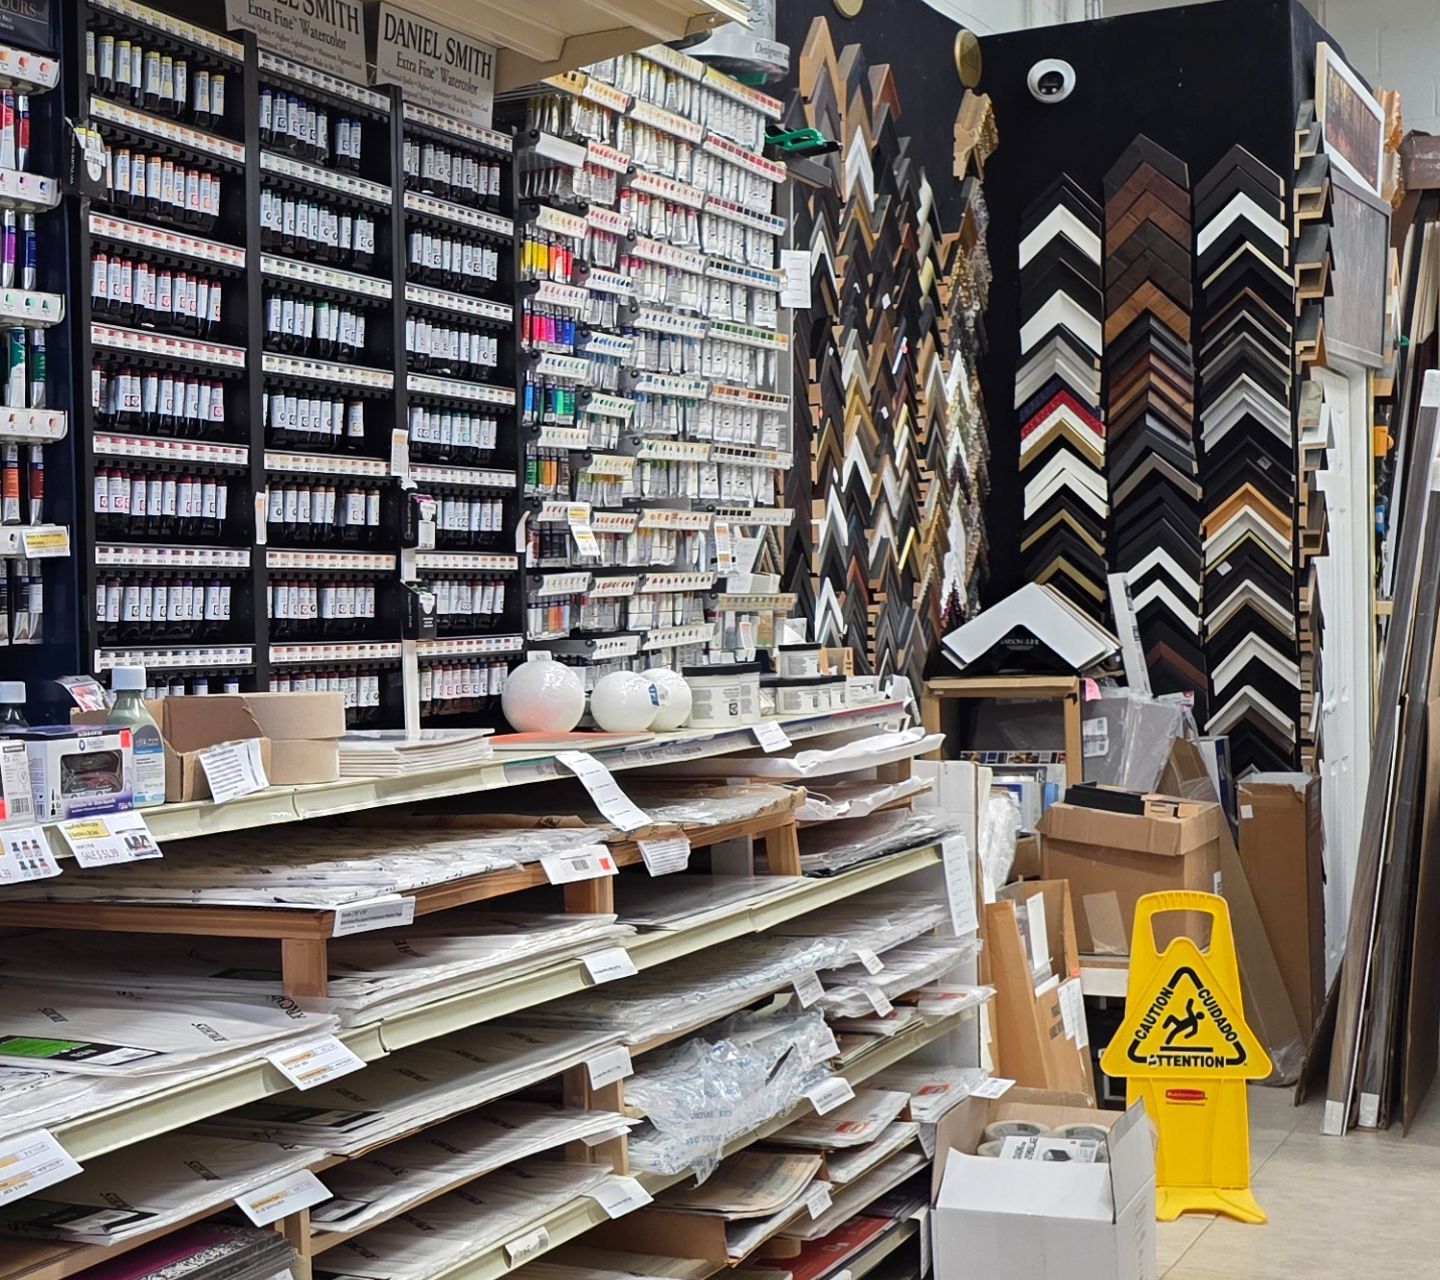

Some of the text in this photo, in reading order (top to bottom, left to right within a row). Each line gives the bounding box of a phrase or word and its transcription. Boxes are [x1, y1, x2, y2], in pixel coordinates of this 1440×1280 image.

[299, 17, 347, 51] Watercolor
[384, 12, 442, 60] DANIEL
[445, 37, 492, 80] SMITH
[396, 51, 417, 74] Extra
[1134, 986, 1174, 1040] CAUTION
[1197, 988, 1238, 1042] CUIDADO
